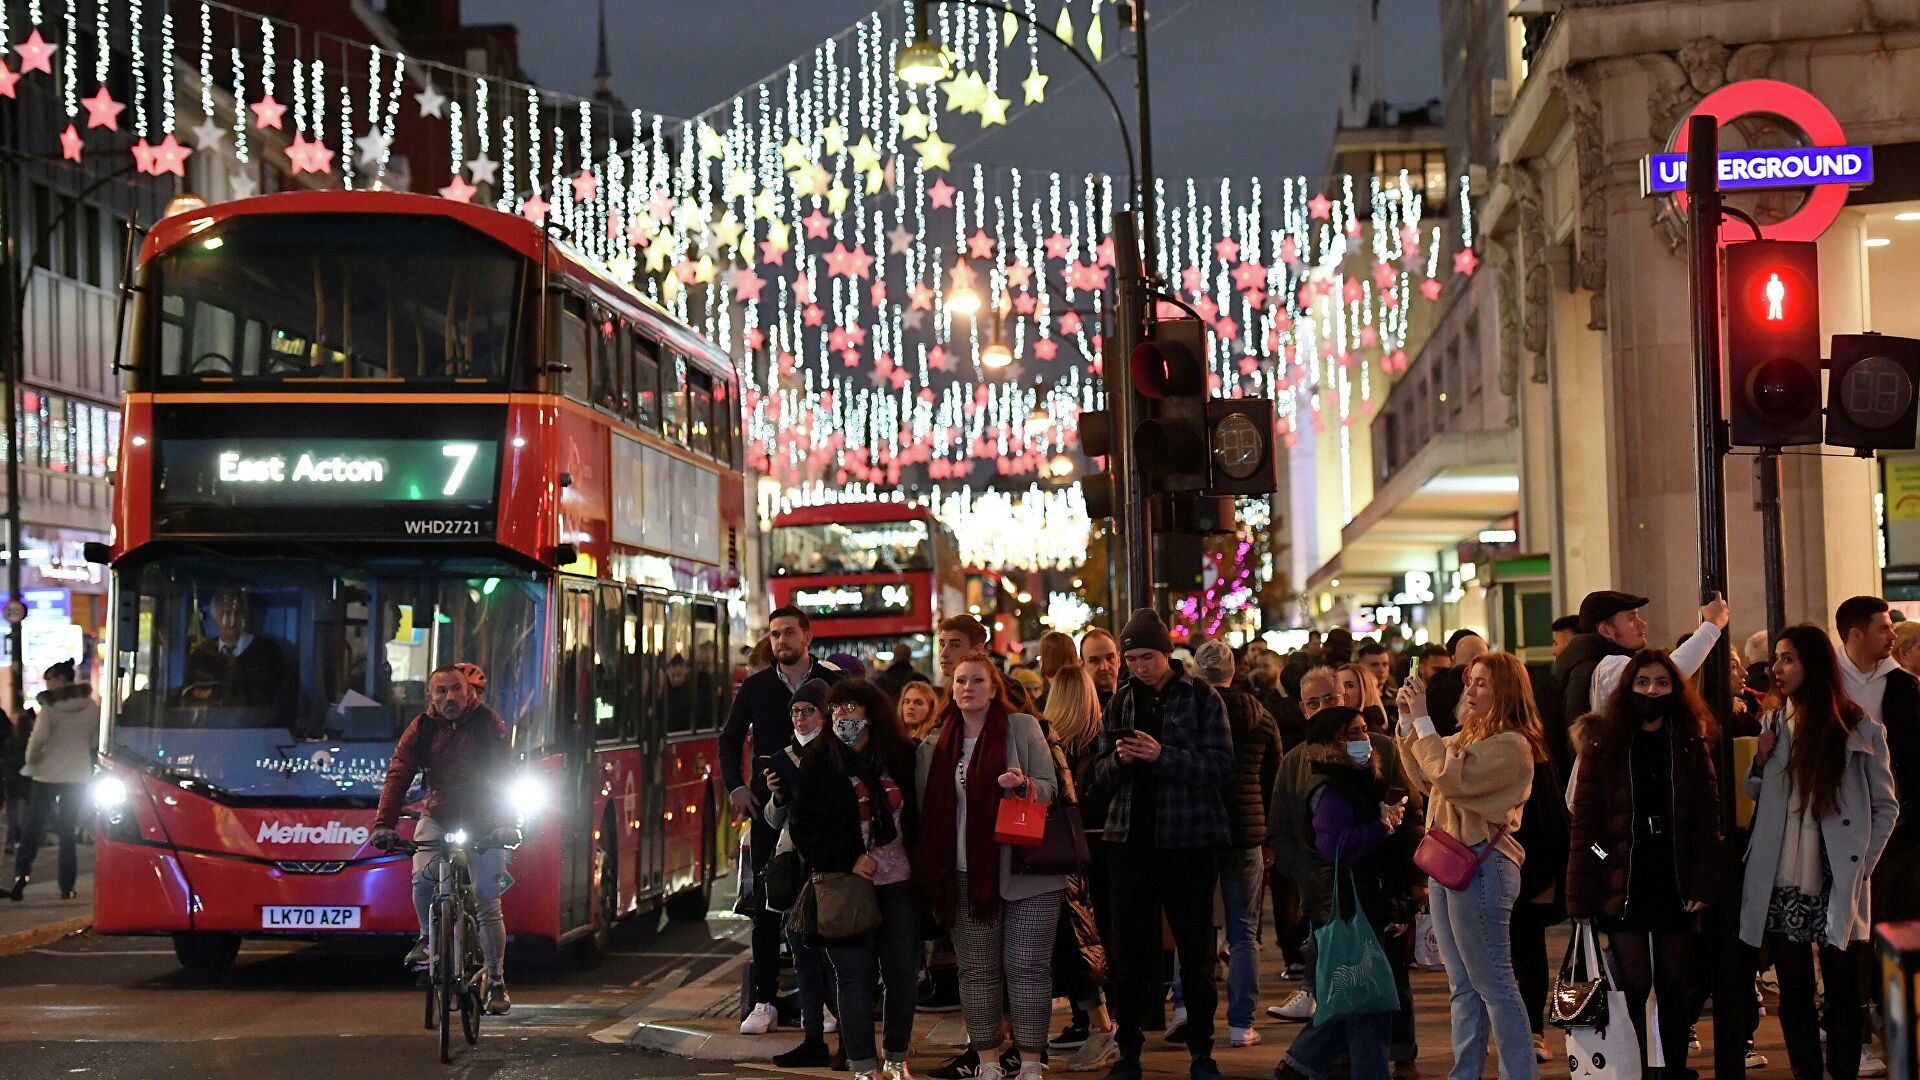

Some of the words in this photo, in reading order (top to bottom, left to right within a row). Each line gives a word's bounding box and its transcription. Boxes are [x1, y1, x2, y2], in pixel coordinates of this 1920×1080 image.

[1659, 153, 1862, 183] UERGROUND
[219, 453, 285, 482] East
[291, 453, 383, 482] Acton
[441, 445, 478, 496] 7
[404, 520, 480, 535] WHD2721
[881, 585, 909, 608] 94
[256, 820, 369, 845] Metroline
[270, 909, 315, 925] LK70
[320, 909, 352, 925] AZP
